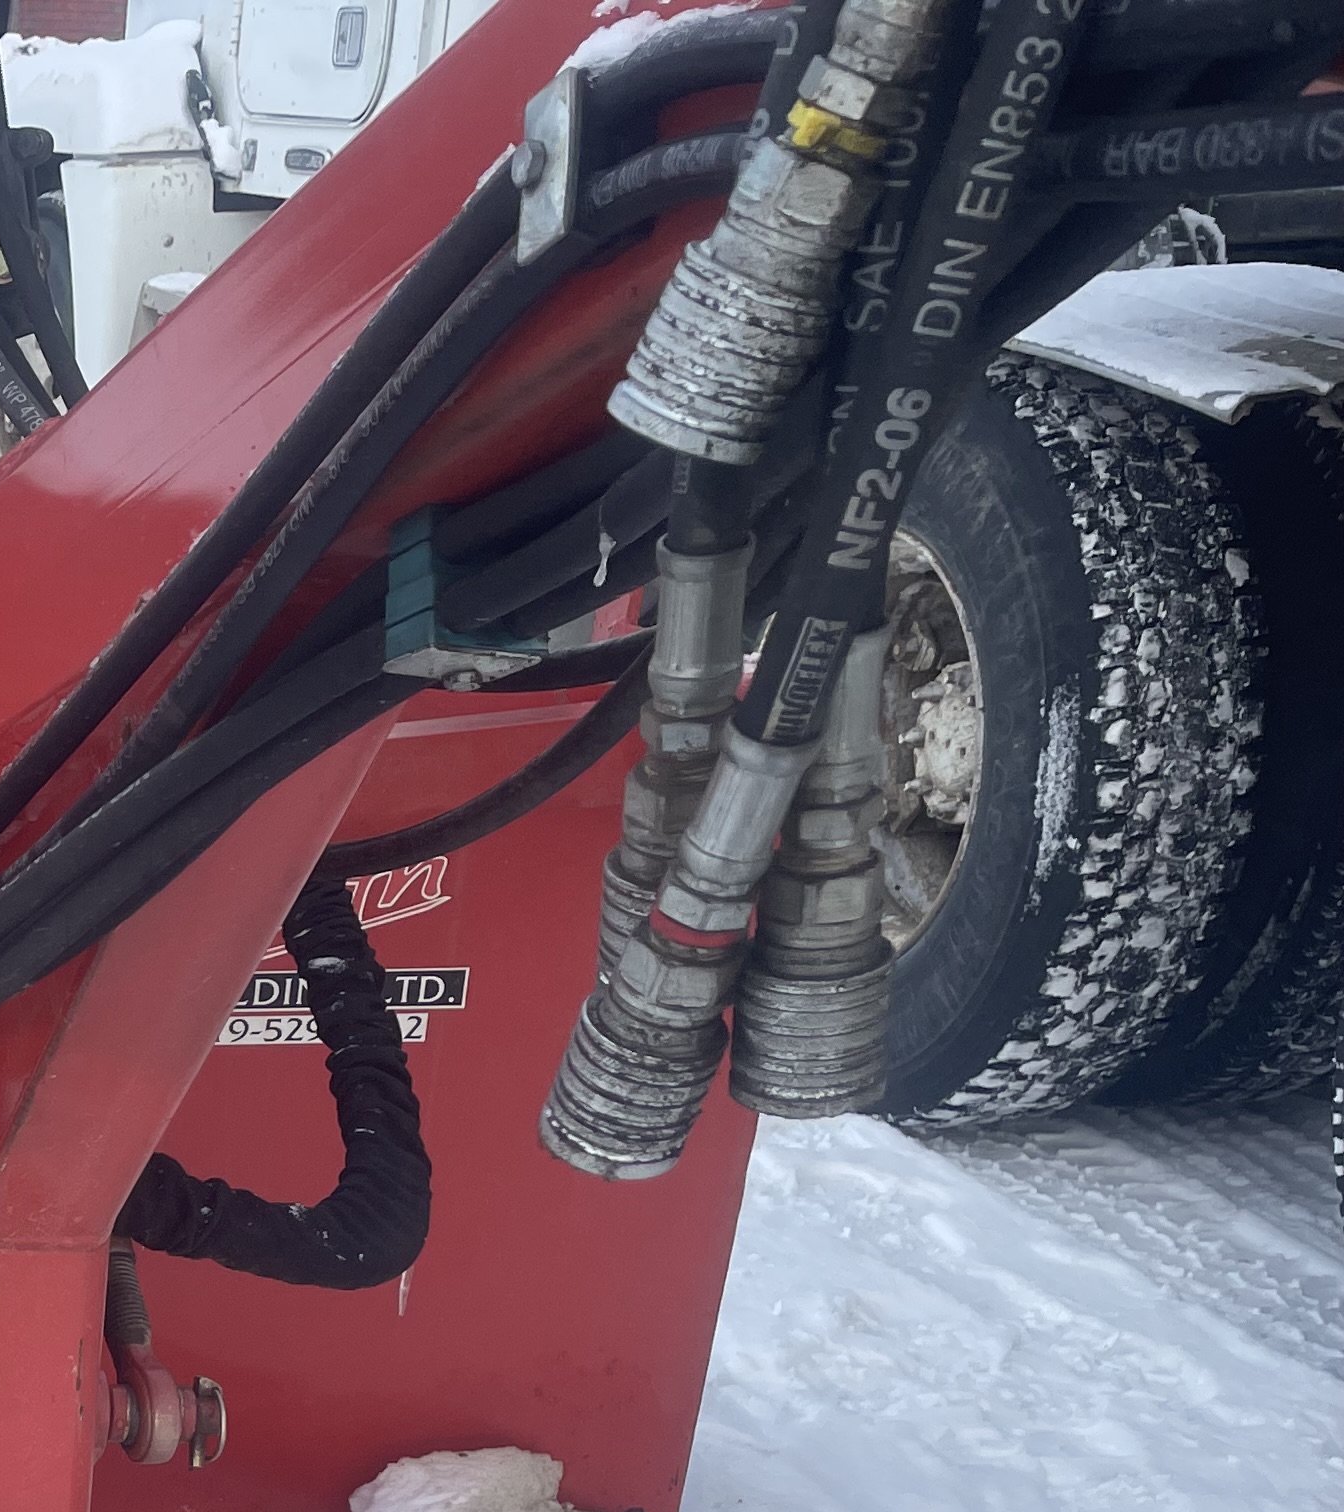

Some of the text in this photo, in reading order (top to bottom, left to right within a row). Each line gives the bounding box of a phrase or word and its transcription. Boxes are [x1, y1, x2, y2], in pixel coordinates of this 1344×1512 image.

[826, 387, 932, 571] NF2-06
[913, 237, 989, 338] DIN
[955, 36, 1064, 221] EN853
[844, 220, 903, 333] SAE
[2, 380, 28, 404] WP
[384, 974, 456, 1005] TD.
